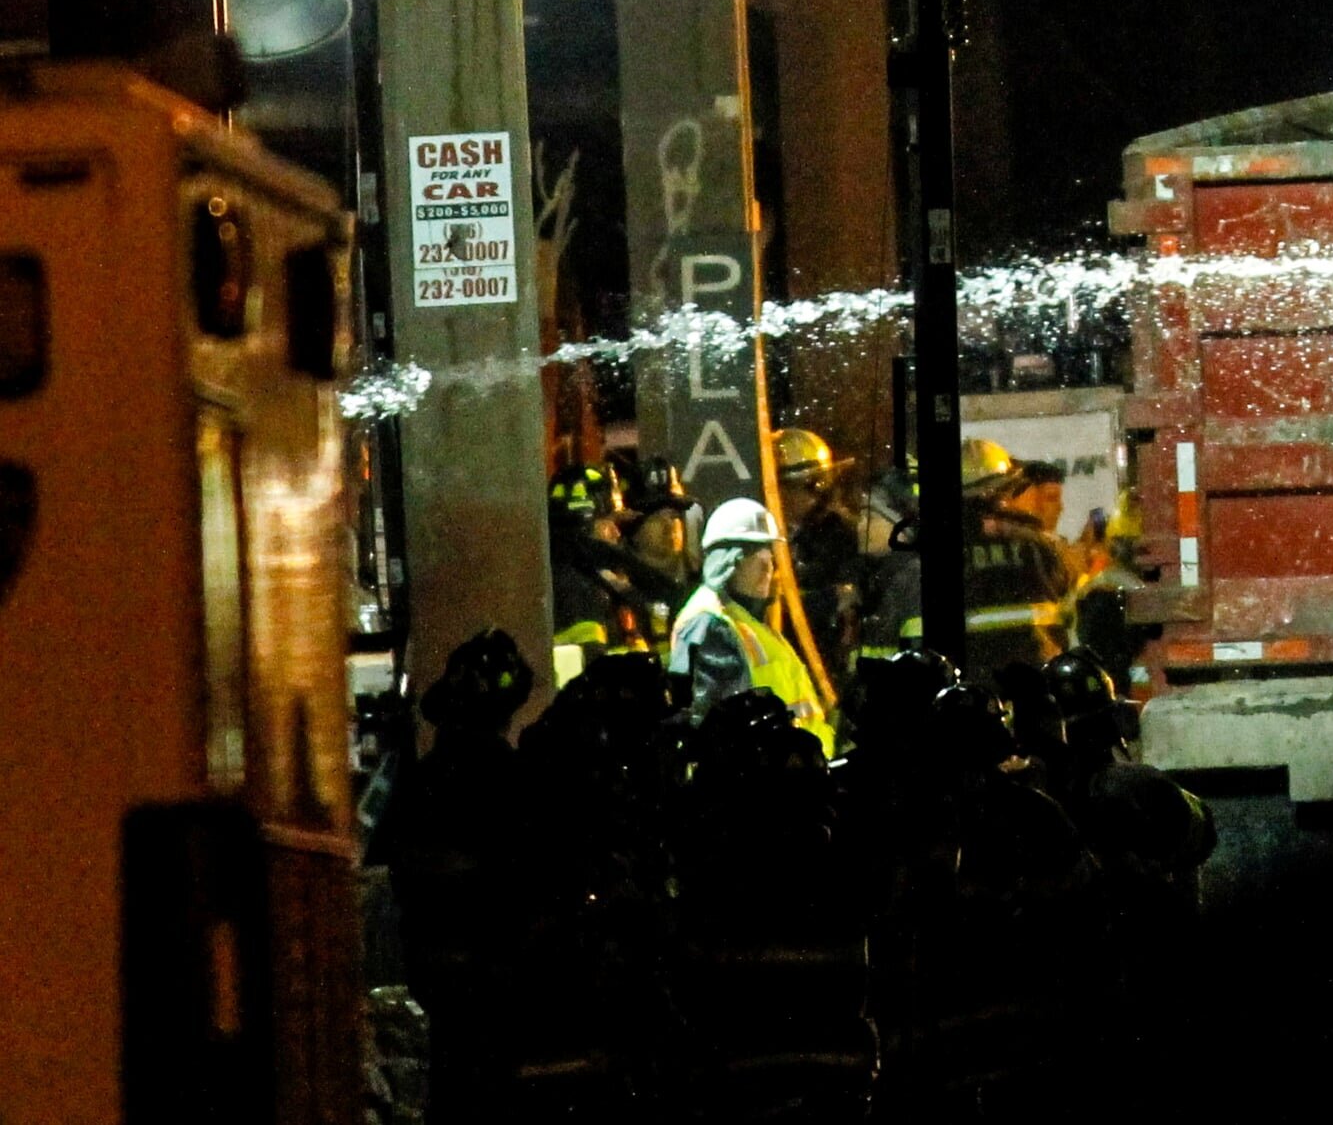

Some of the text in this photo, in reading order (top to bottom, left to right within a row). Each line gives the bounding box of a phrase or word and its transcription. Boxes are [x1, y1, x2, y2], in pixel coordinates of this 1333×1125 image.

[432, 169, 491, 181] FOR ANY
[424, 183, 499, 199] CAR
[420, 241, 508, 262] 2320007
[420, 278, 508, 299] 232-0007
